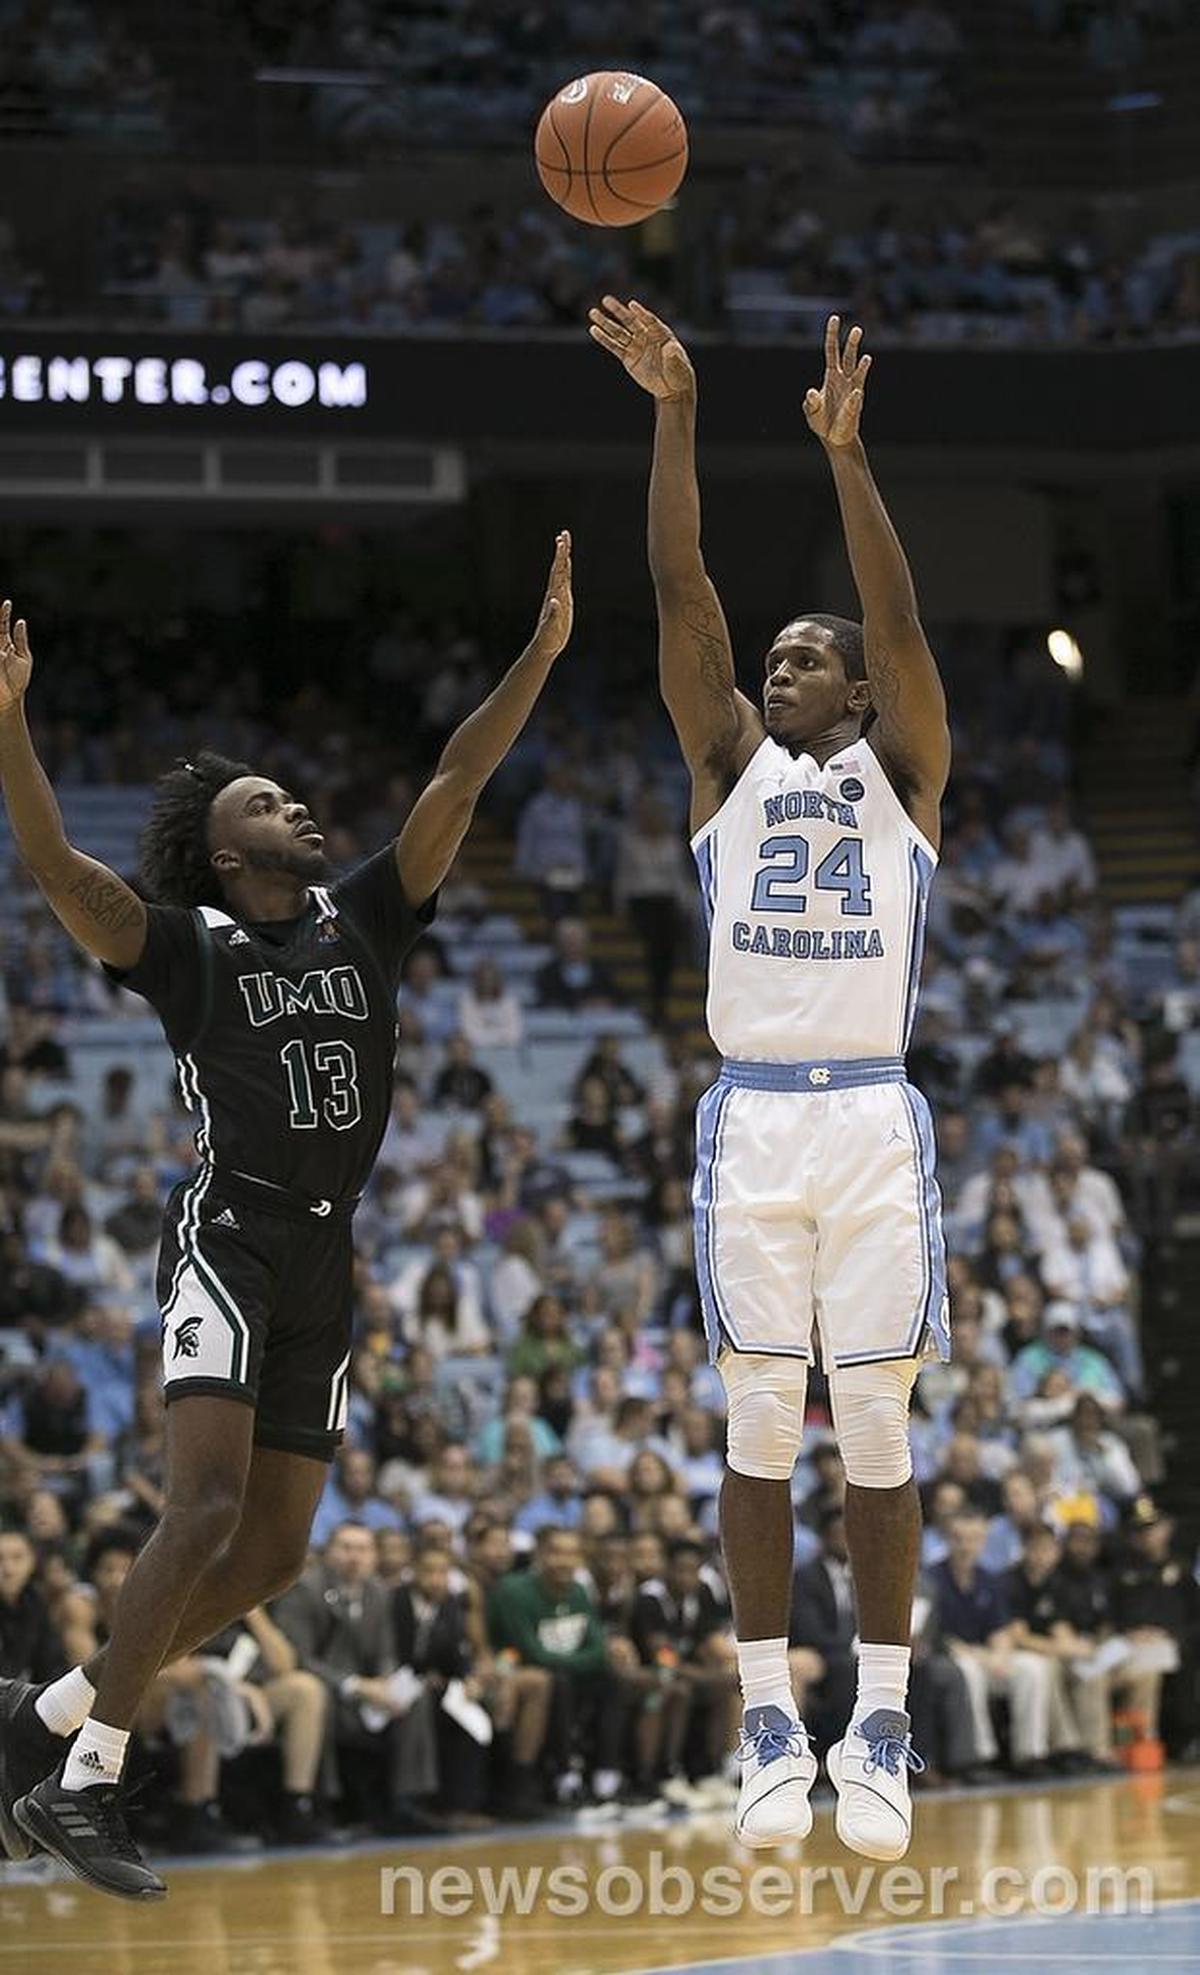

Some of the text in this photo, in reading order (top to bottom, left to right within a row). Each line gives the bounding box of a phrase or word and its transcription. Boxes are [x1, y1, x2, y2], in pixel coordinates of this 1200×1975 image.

[0, 355, 366, 407] ENTER.COM
[764, 790, 857, 828] NORTH
[751, 835, 872, 916] 24
[733, 922, 884, 960] CAROLINA
[238, 965, 369, 1027] UMO
[281, 1039, 362, 1131] 13
